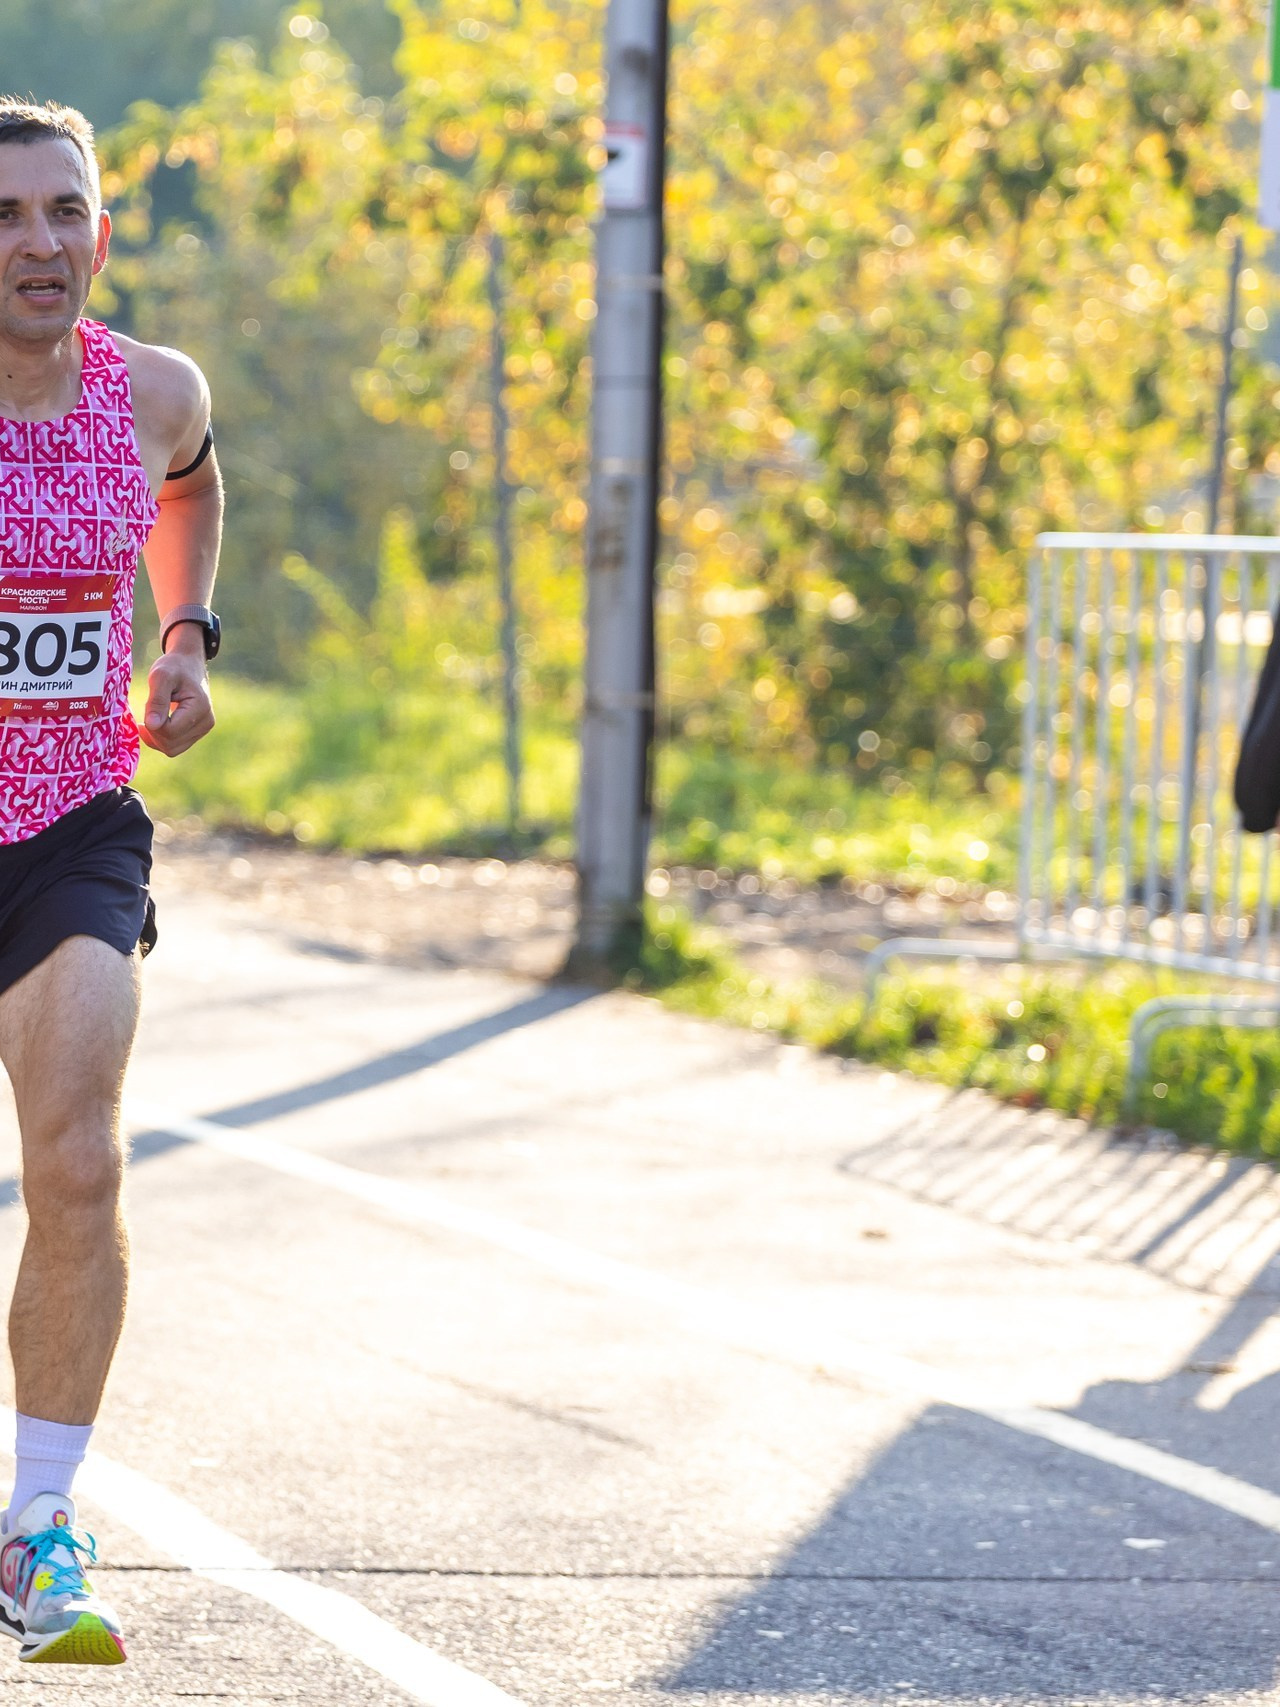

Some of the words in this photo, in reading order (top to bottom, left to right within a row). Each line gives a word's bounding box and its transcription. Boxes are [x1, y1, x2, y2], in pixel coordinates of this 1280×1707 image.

[0, 587, 66, 597] КРАСНОЯРСКИЕ
[83, 592, 89, 601] 5
[90, 592, 103, 601] КМ
[19, 596, 50, 605] МОСТЫ
[19, 679, 73, 693] ДМИТРИЙ
[69, 701, 89, 710] 2026
